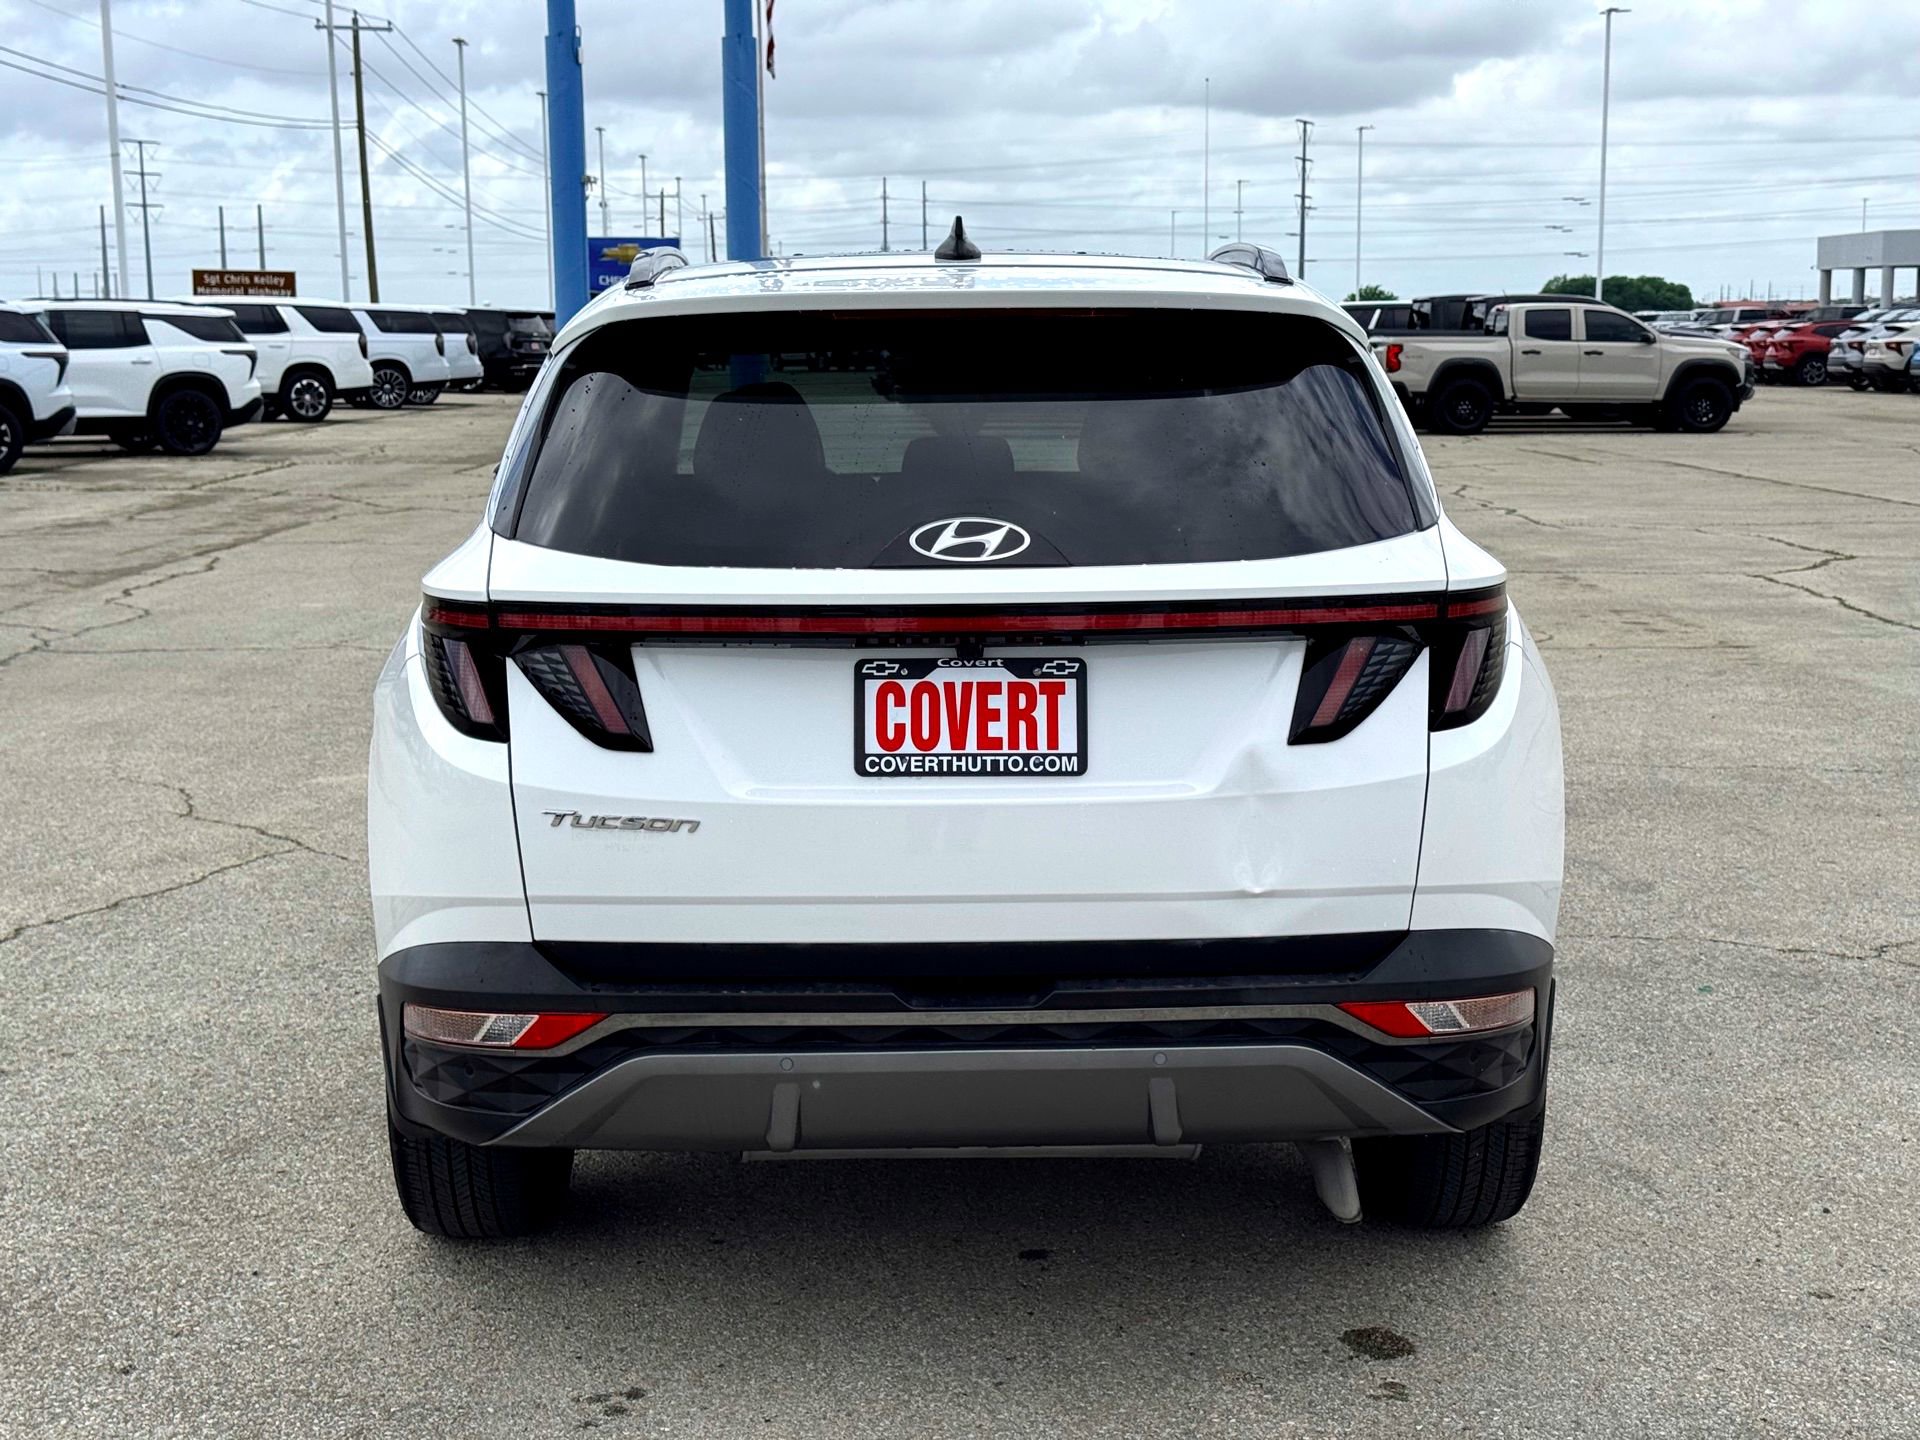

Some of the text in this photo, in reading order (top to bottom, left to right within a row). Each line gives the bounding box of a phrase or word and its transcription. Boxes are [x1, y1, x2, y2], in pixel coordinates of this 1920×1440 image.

[203, 274, 285, 286] Sgt Chris Kelley
[197, 286, 244, 295] Memorial
[937, 658, 1004, 668] Covert
[876, 681, 1066, 752] COVERT
[865, 756, 1078, 773] COVERTHUTTO.COM
